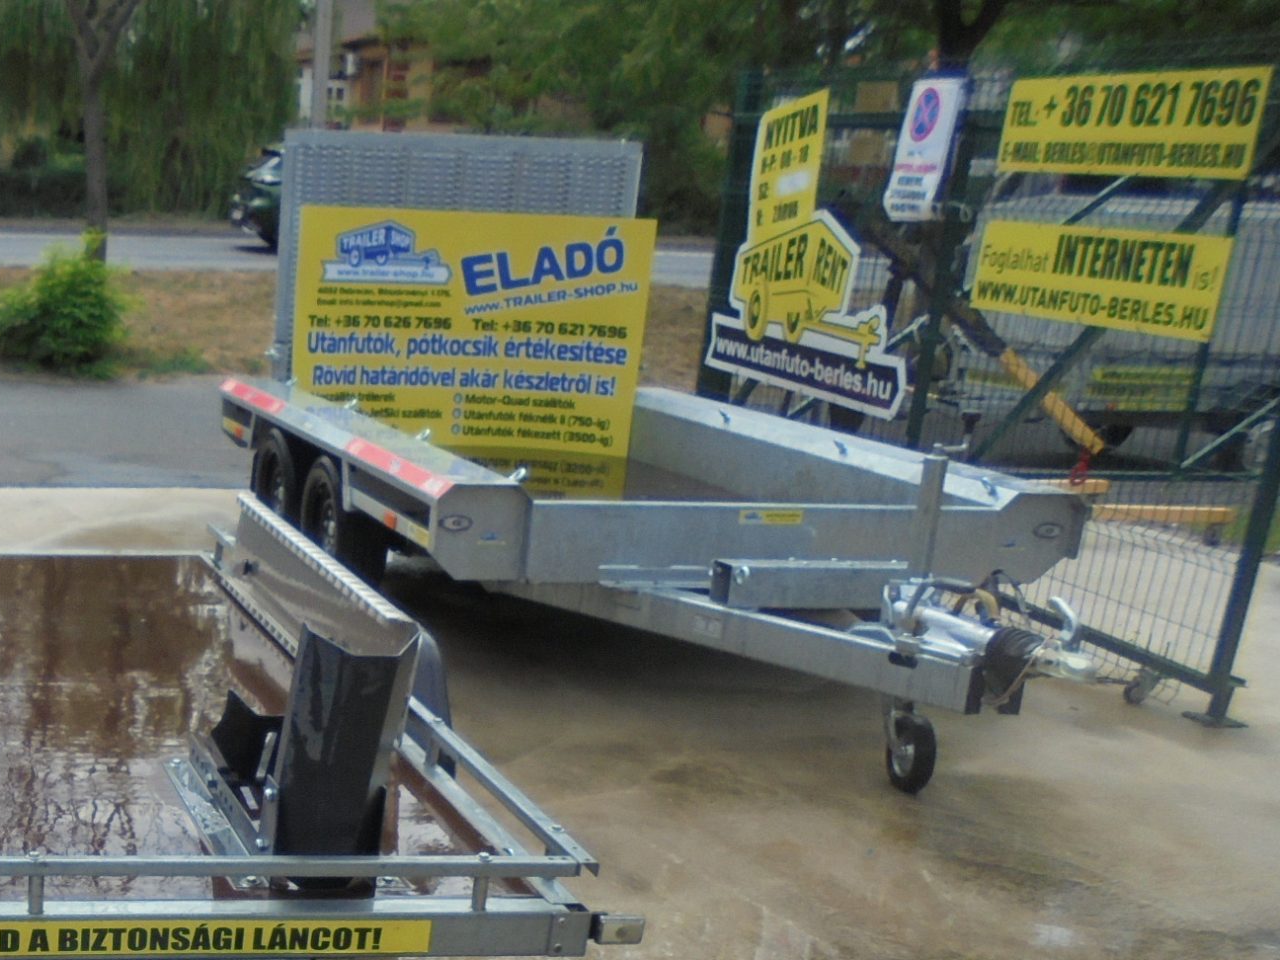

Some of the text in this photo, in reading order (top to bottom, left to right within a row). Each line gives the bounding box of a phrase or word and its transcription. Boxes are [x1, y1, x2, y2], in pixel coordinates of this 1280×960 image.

[1096, 83, 1129, 127] 70
[1129, 81, 1183, 127] 621
[1184, 78, 1261, 127] 7696
[763, 103, 818, 151] NYITVA
[342, 228, 412, 250] TRAILER SHOP
[461, 224, 625, 296] ELADÓ
[742, 233, 849, 295] TRAILER RENT
[981, 233, 1219, 293] Foglalhat INTERNETEN is!
[464, 281, 638, 315] www.TRAILER-SHOP.hu
[976, 280, 1209, 331] WWW.UTANFUTO-BERLES.HU
[309, 314, 452, 330] Tel: +36 70 626 7696
[472, 318, 628, 340] Tel: +36 70 621 7696
[307, 331, 628, 366] Utánfutók, pótkocsik értékesítése
[717, 336, 892, 400] www.utanfuto-berles.hu
[312, 364, 617, 397] Rövid határidővel akár készletről is!
[27, 928, 50, 953] A
[57, 923, 246, 953] BIZTONSÁGI
[252, 923, 383, 951] LÁNCOT!
